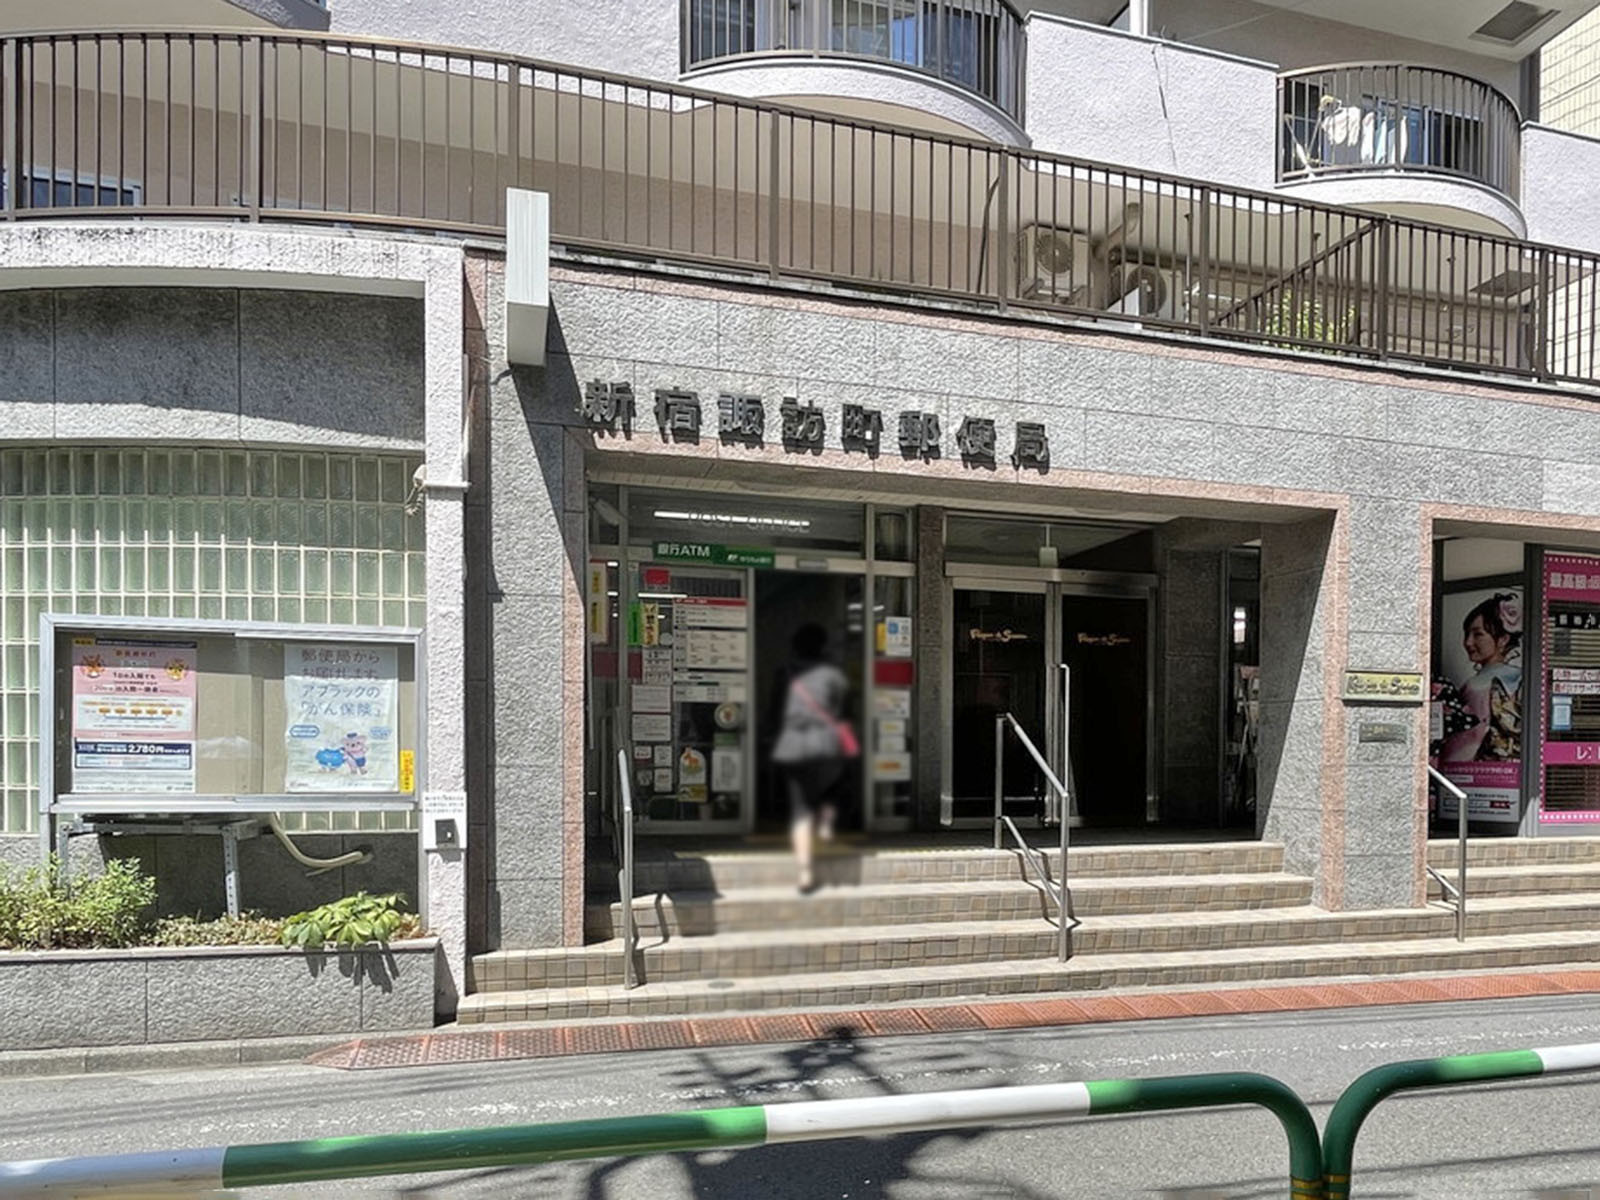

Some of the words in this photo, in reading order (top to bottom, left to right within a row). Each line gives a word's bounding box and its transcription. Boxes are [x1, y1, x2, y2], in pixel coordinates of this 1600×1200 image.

[584, 378, 1050, 468] 新宿諏訪町郵便局
[657, 543, 710, 557] 銀行ATM
[302, 648, 380, 664] 郵便局から
